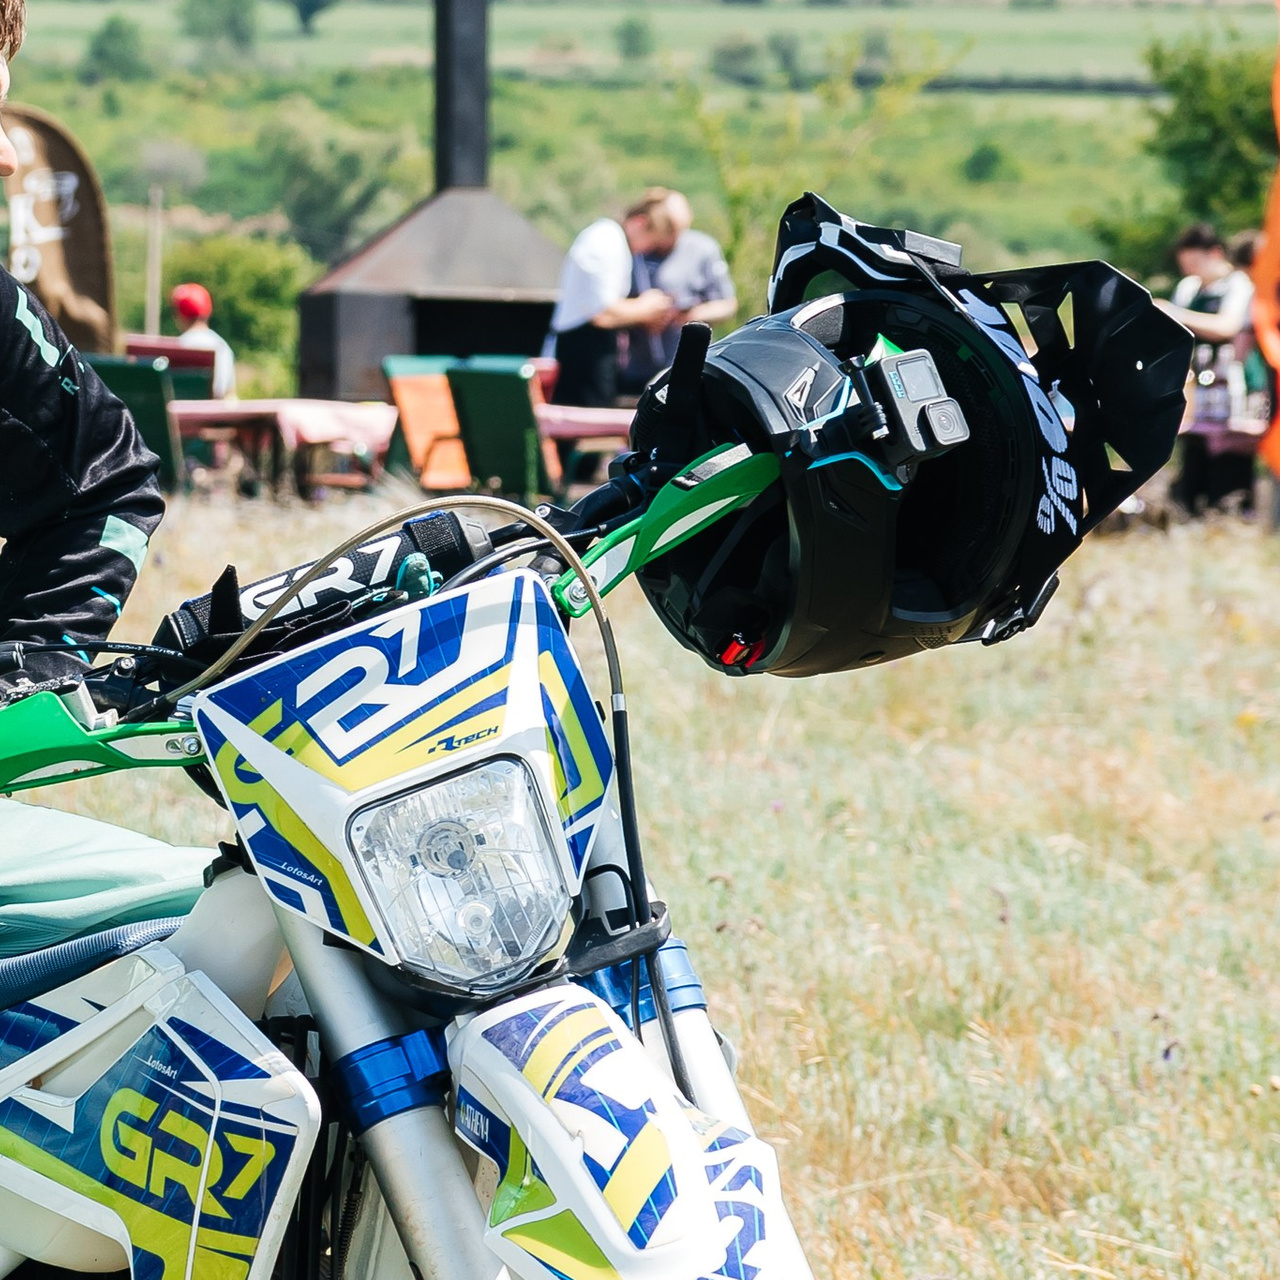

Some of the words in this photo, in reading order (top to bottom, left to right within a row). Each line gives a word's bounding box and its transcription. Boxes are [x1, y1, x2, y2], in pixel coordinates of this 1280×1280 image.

[957, 287, 1079, 537] 100%
[238, 535, 402, 622] GR7
[280, 862, 323, 886] LotosArt
[146, 1055, 178, 1080] LotosArt
[100, 1087, 276, 1219] GR7
